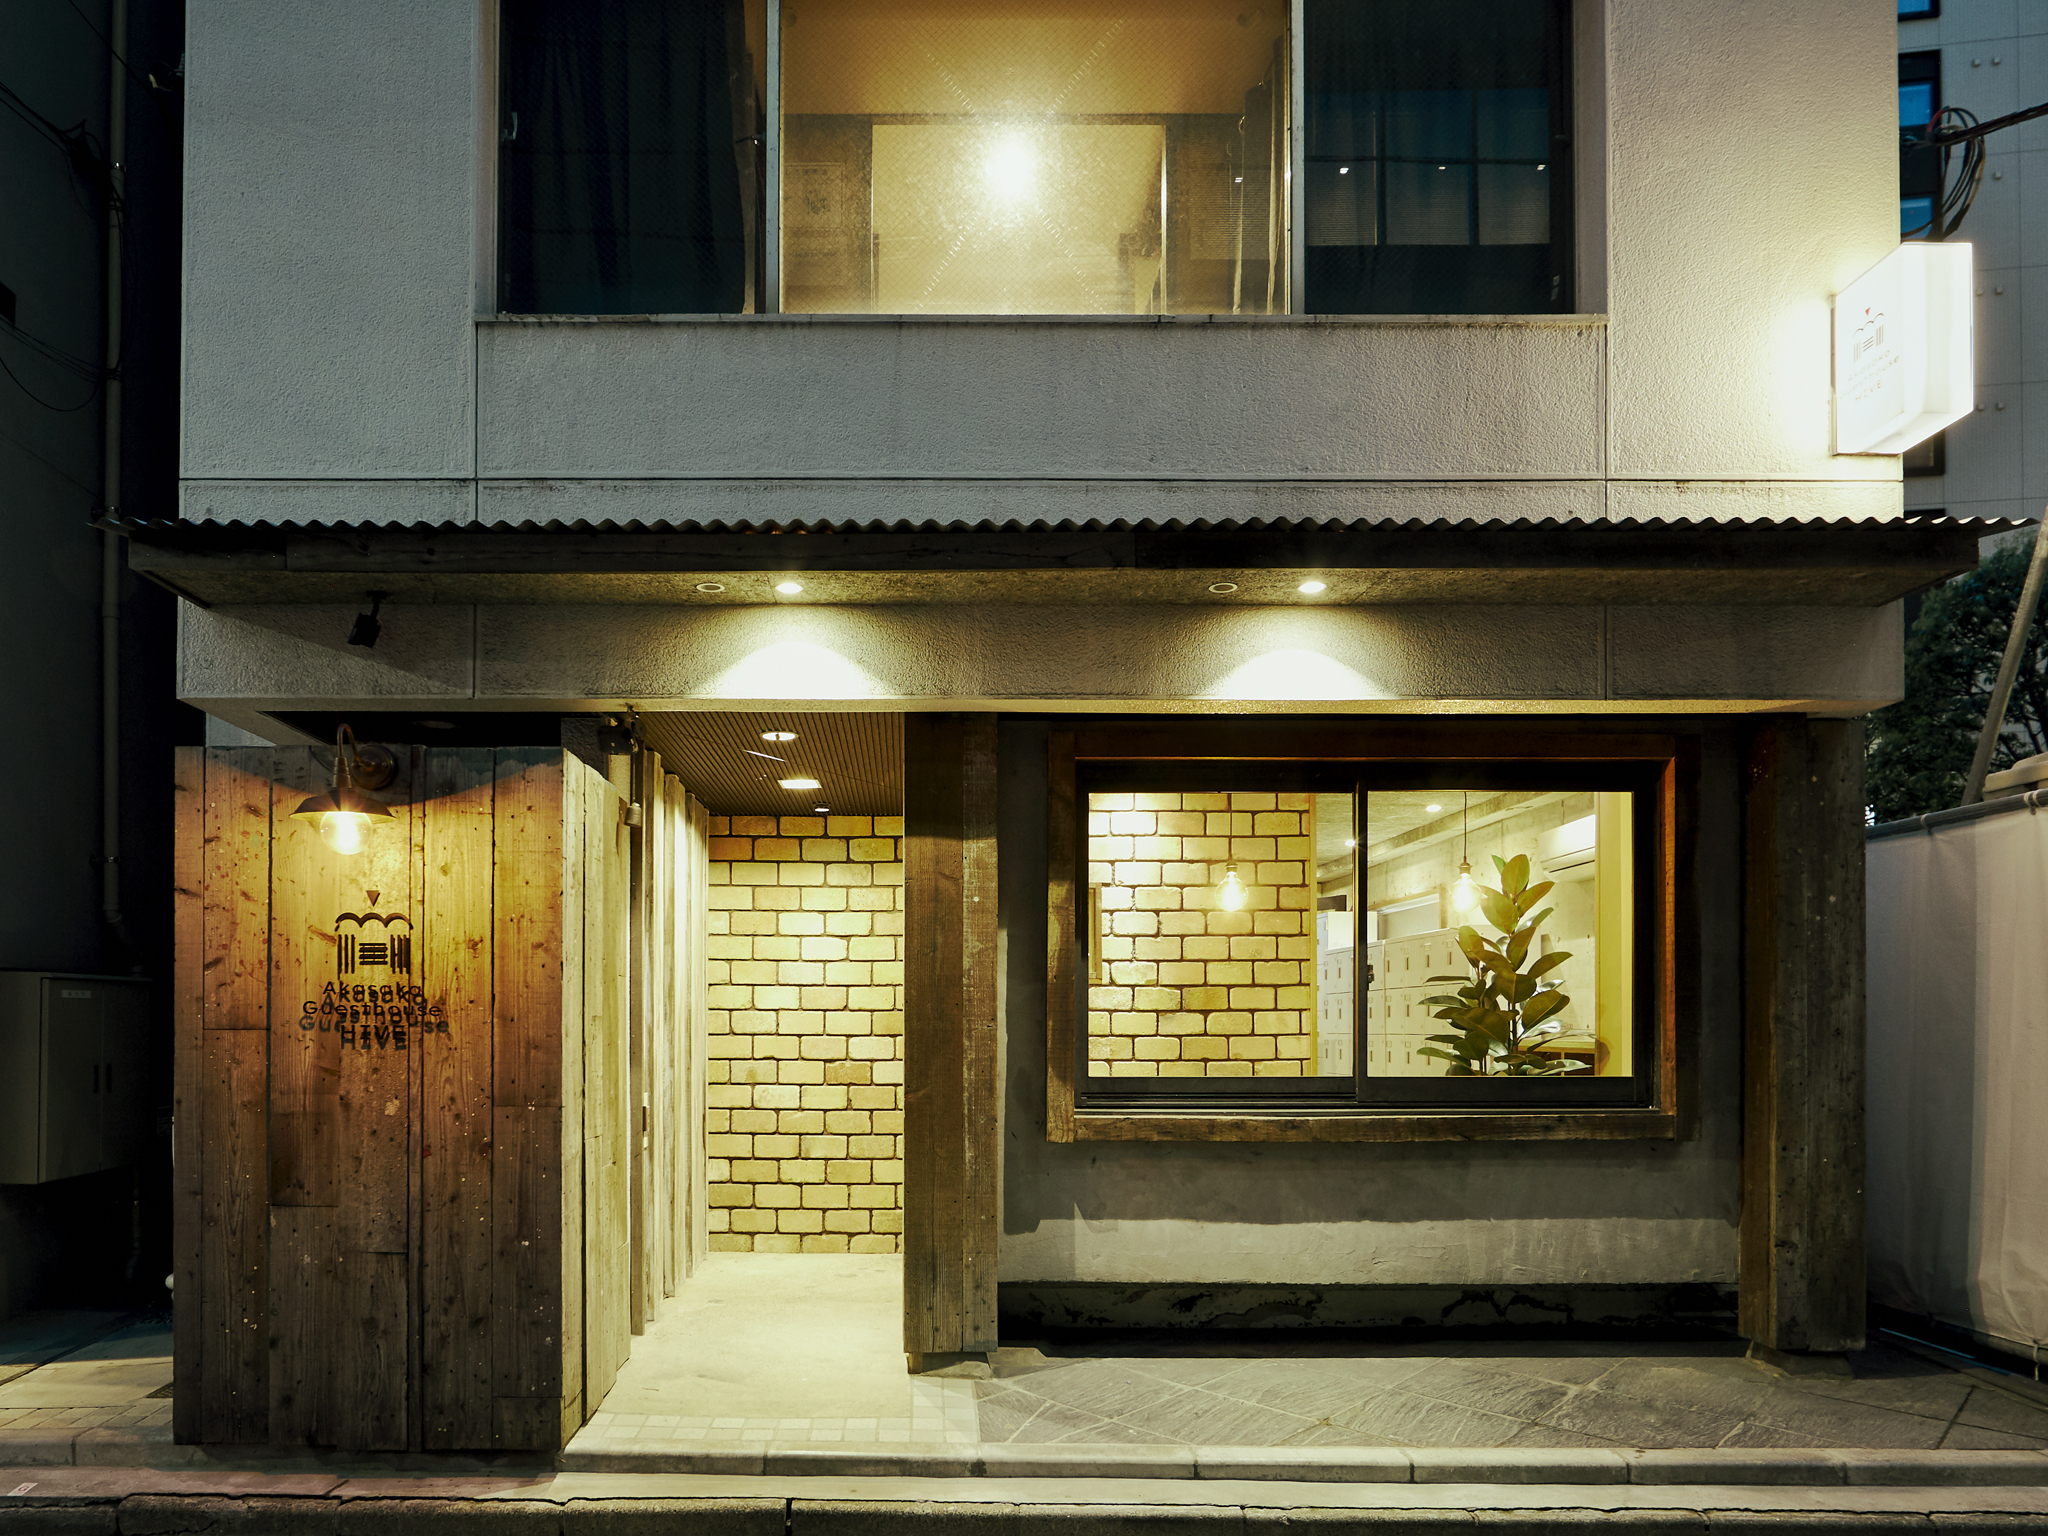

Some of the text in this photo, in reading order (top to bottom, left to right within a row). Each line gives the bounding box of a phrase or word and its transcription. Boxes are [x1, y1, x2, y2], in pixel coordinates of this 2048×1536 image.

[322, 981, 423, 996] Akasaka
[302, 1000, 442, 1017] Guesthouse
[341, 1024, 406, 1040] HIVE
